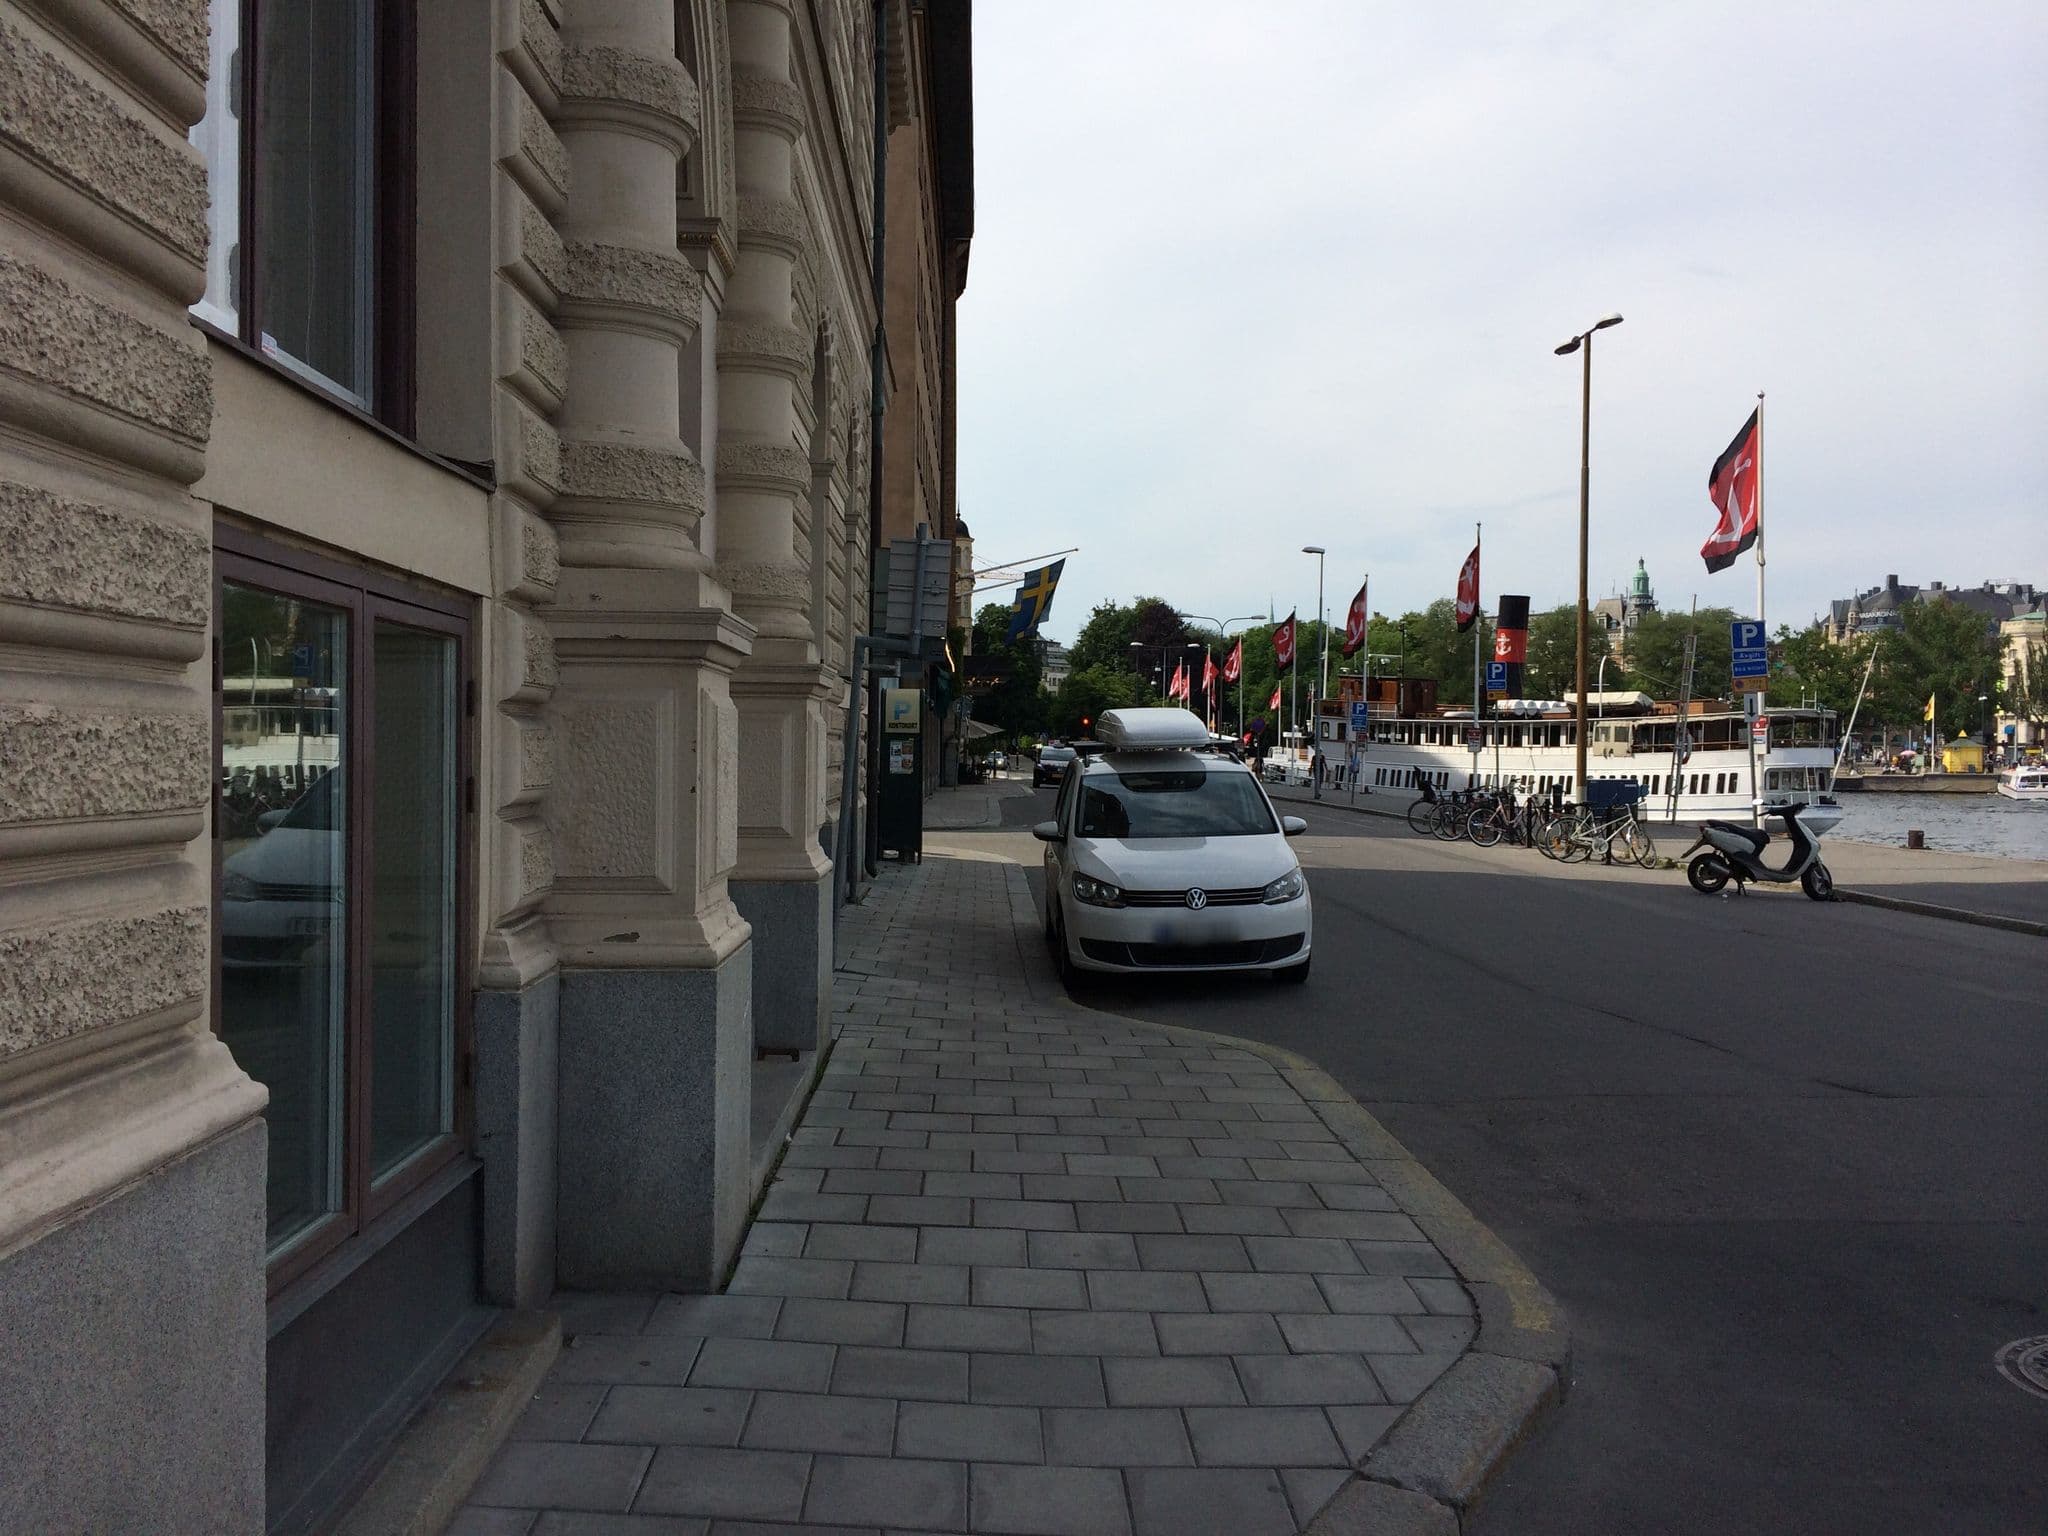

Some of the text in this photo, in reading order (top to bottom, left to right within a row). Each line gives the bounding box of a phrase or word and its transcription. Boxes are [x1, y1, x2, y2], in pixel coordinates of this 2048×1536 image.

[1742, 624, 1758, 647] P
[1491, 664, 1503, 679] P
[894, 701, 912, 720] P
[1356, 703, 1365, 714] P
